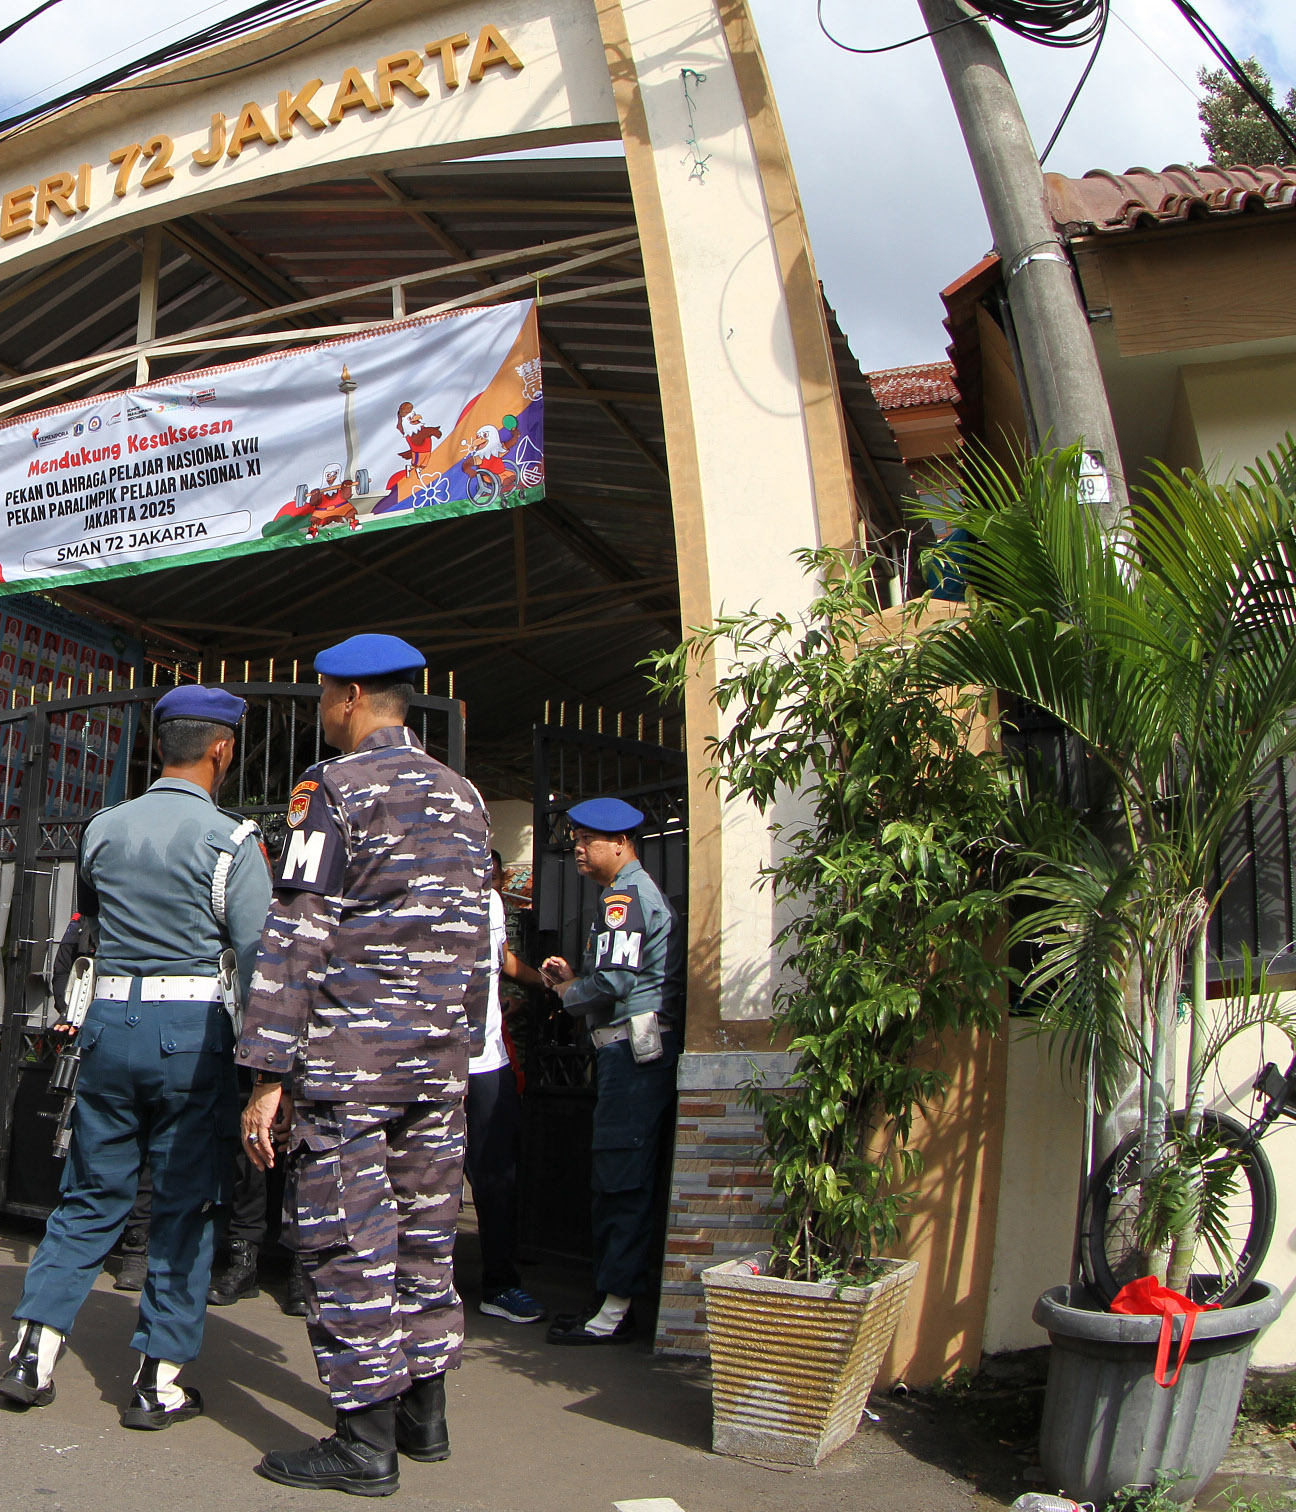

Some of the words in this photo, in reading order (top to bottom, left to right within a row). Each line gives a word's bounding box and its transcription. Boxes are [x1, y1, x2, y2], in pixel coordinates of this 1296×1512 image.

[109, 134, 174, 197] 72
[192, 25, 524, 167] JAKARTA
[5, 485, 43, 506] PEKAN
[46, 471, 107, 497] OLAHRAGA
[109, 457, 164, 484] PELAJAR
[167, 444, 229, 471] NASIONAL
[232, 437, 259, 457] XVII
[27, 443, 121, 477] Mendukung
[127, 419, 233, 454] Kesuksesan
[7, 506, 46, 526] PEKAN
[49, 488, 116, 519] PARALIMPIK
[120, 477, 177, 500] PELAJAR
[180, 463, 244, 491] NASIONAL
[246, 458, 261, 476] XI
[83, 505, 136, 531] JAKARTA
[139, 498, 176, 520] 2025
[56, 540, 101, 562] SMAN
[105, 530, 123, 552] 72
[128, 522, 208, 548] JAKARTA
[281, 829, 326, 883] M
[595, 930, 642, 968] PM
